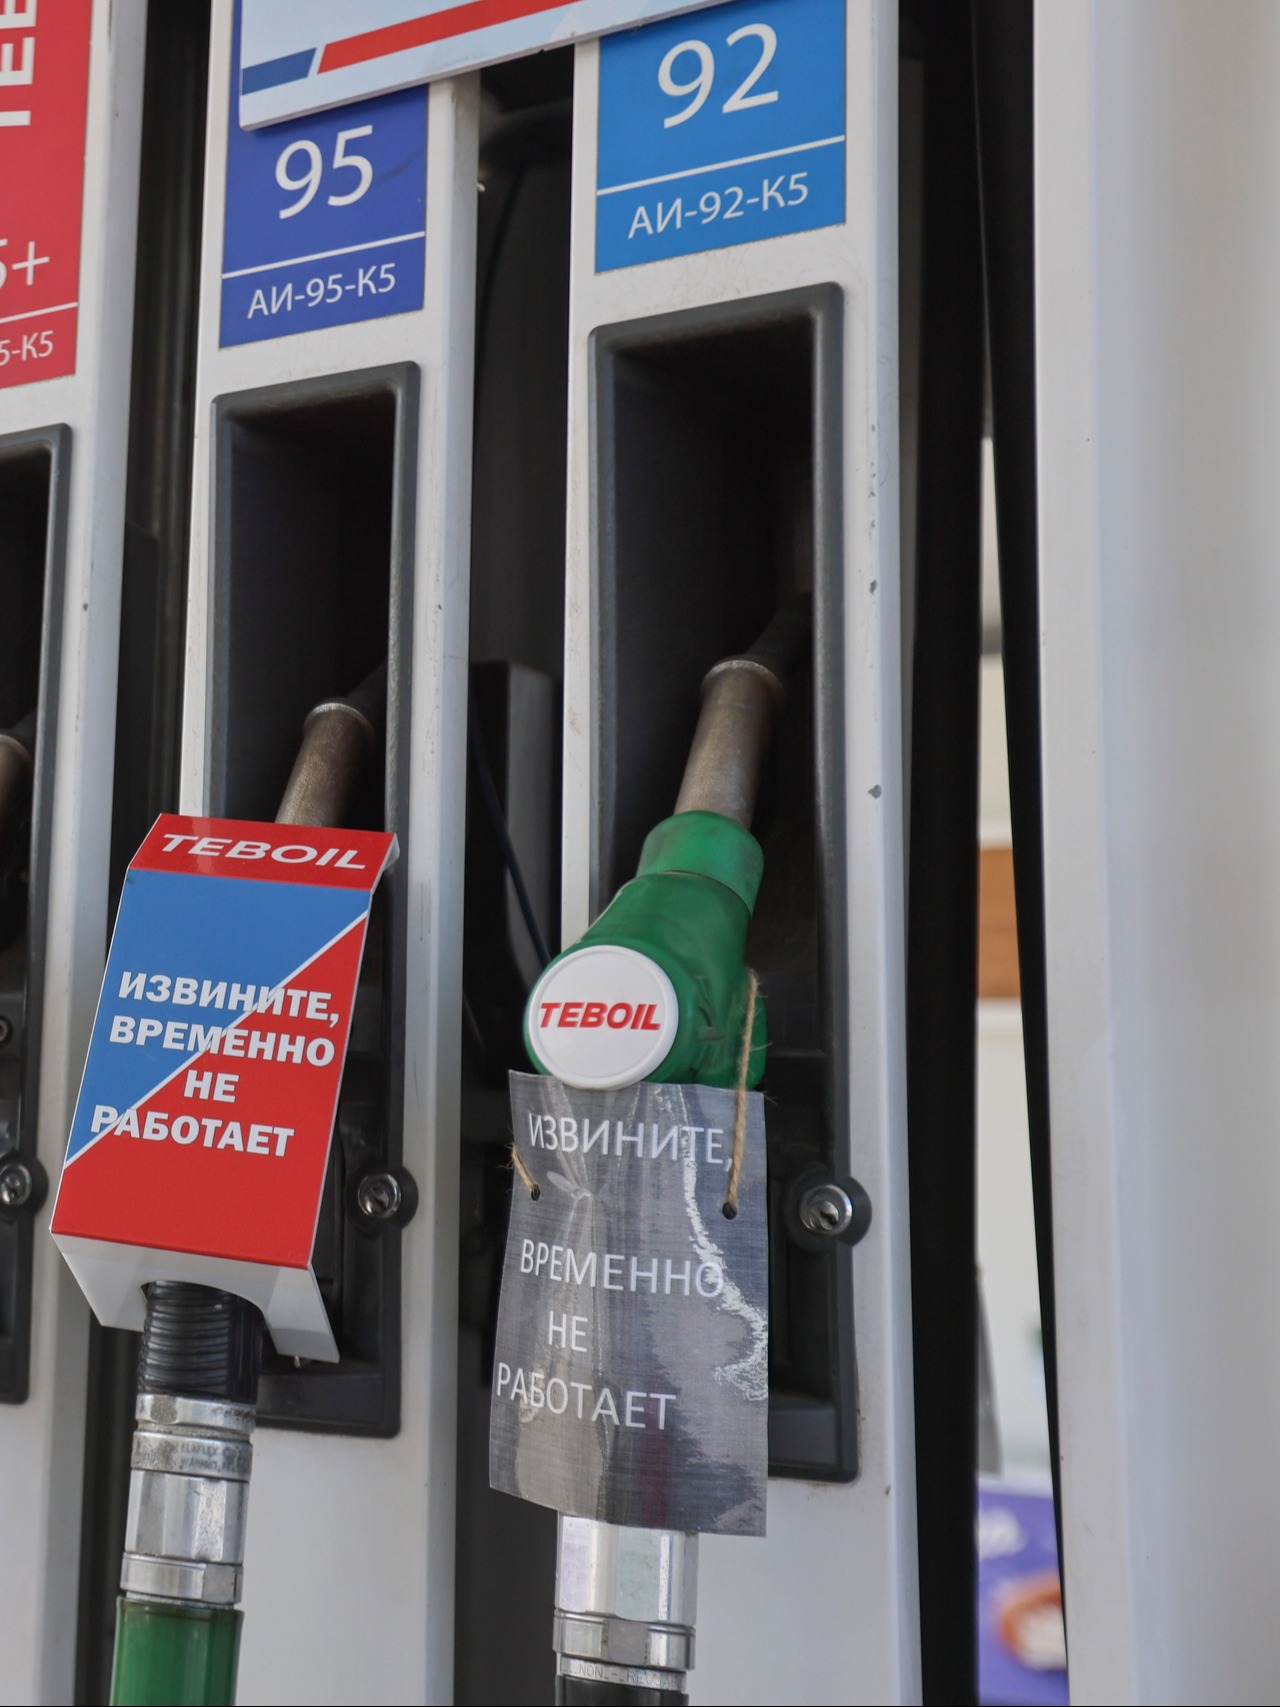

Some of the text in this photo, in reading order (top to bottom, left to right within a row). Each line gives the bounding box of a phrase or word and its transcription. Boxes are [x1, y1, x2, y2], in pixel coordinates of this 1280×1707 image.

[657, 23, 780, 130] 92
[275, 124, 374, 220] 95
[627, 172, 810, 240] АИ-92-К5
[247, 263, 397, 320] АИ-95-К5
[162, 833, 366, 870] TEBOIL
[118, 971, 340, 1028] ИЗВИНИТЕ,
[538, 1001, 661, 1031] TEBOIL
[109, 1015, 336, 1067] ВРЕМЕННО
[183, 1069, 240, 1104] НЕ
[90, 1104, 295, 1158] РАБОТАЕТ
[527, 1112, 734, 1172] ИЗВИНИТЕ,
[520, 1238, 724, 1298] ВРЕМЕННО
[547, 1310, 588, 1353] НЕ
[496, 1362, 676, 1430] РАБОТАЕТ
